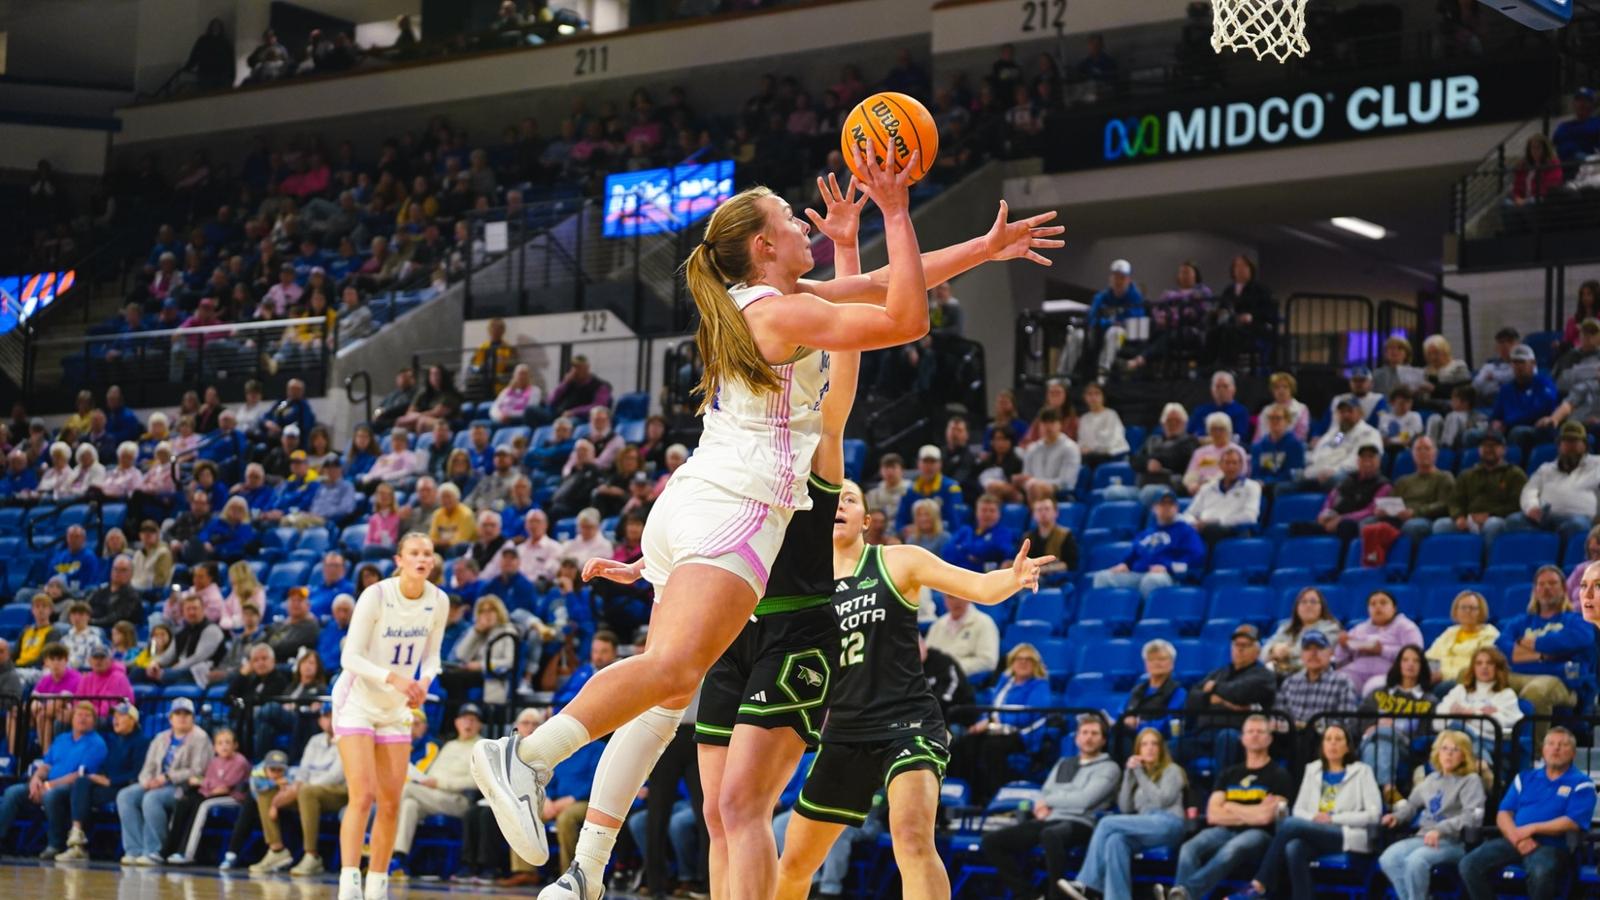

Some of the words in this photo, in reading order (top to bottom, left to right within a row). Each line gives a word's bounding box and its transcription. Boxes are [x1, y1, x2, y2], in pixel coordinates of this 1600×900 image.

[1022, 0, 1067, 31] 212
[575, 45, 608, 76] 211
[1167, 92, 1325, 153] MIDCO
[1346, 75, 1480, 131] CLUB
[872, 101, 910, 159] Wilson
[582, 311, 607, 332] 212
[390, 643, 414, 665] 11
